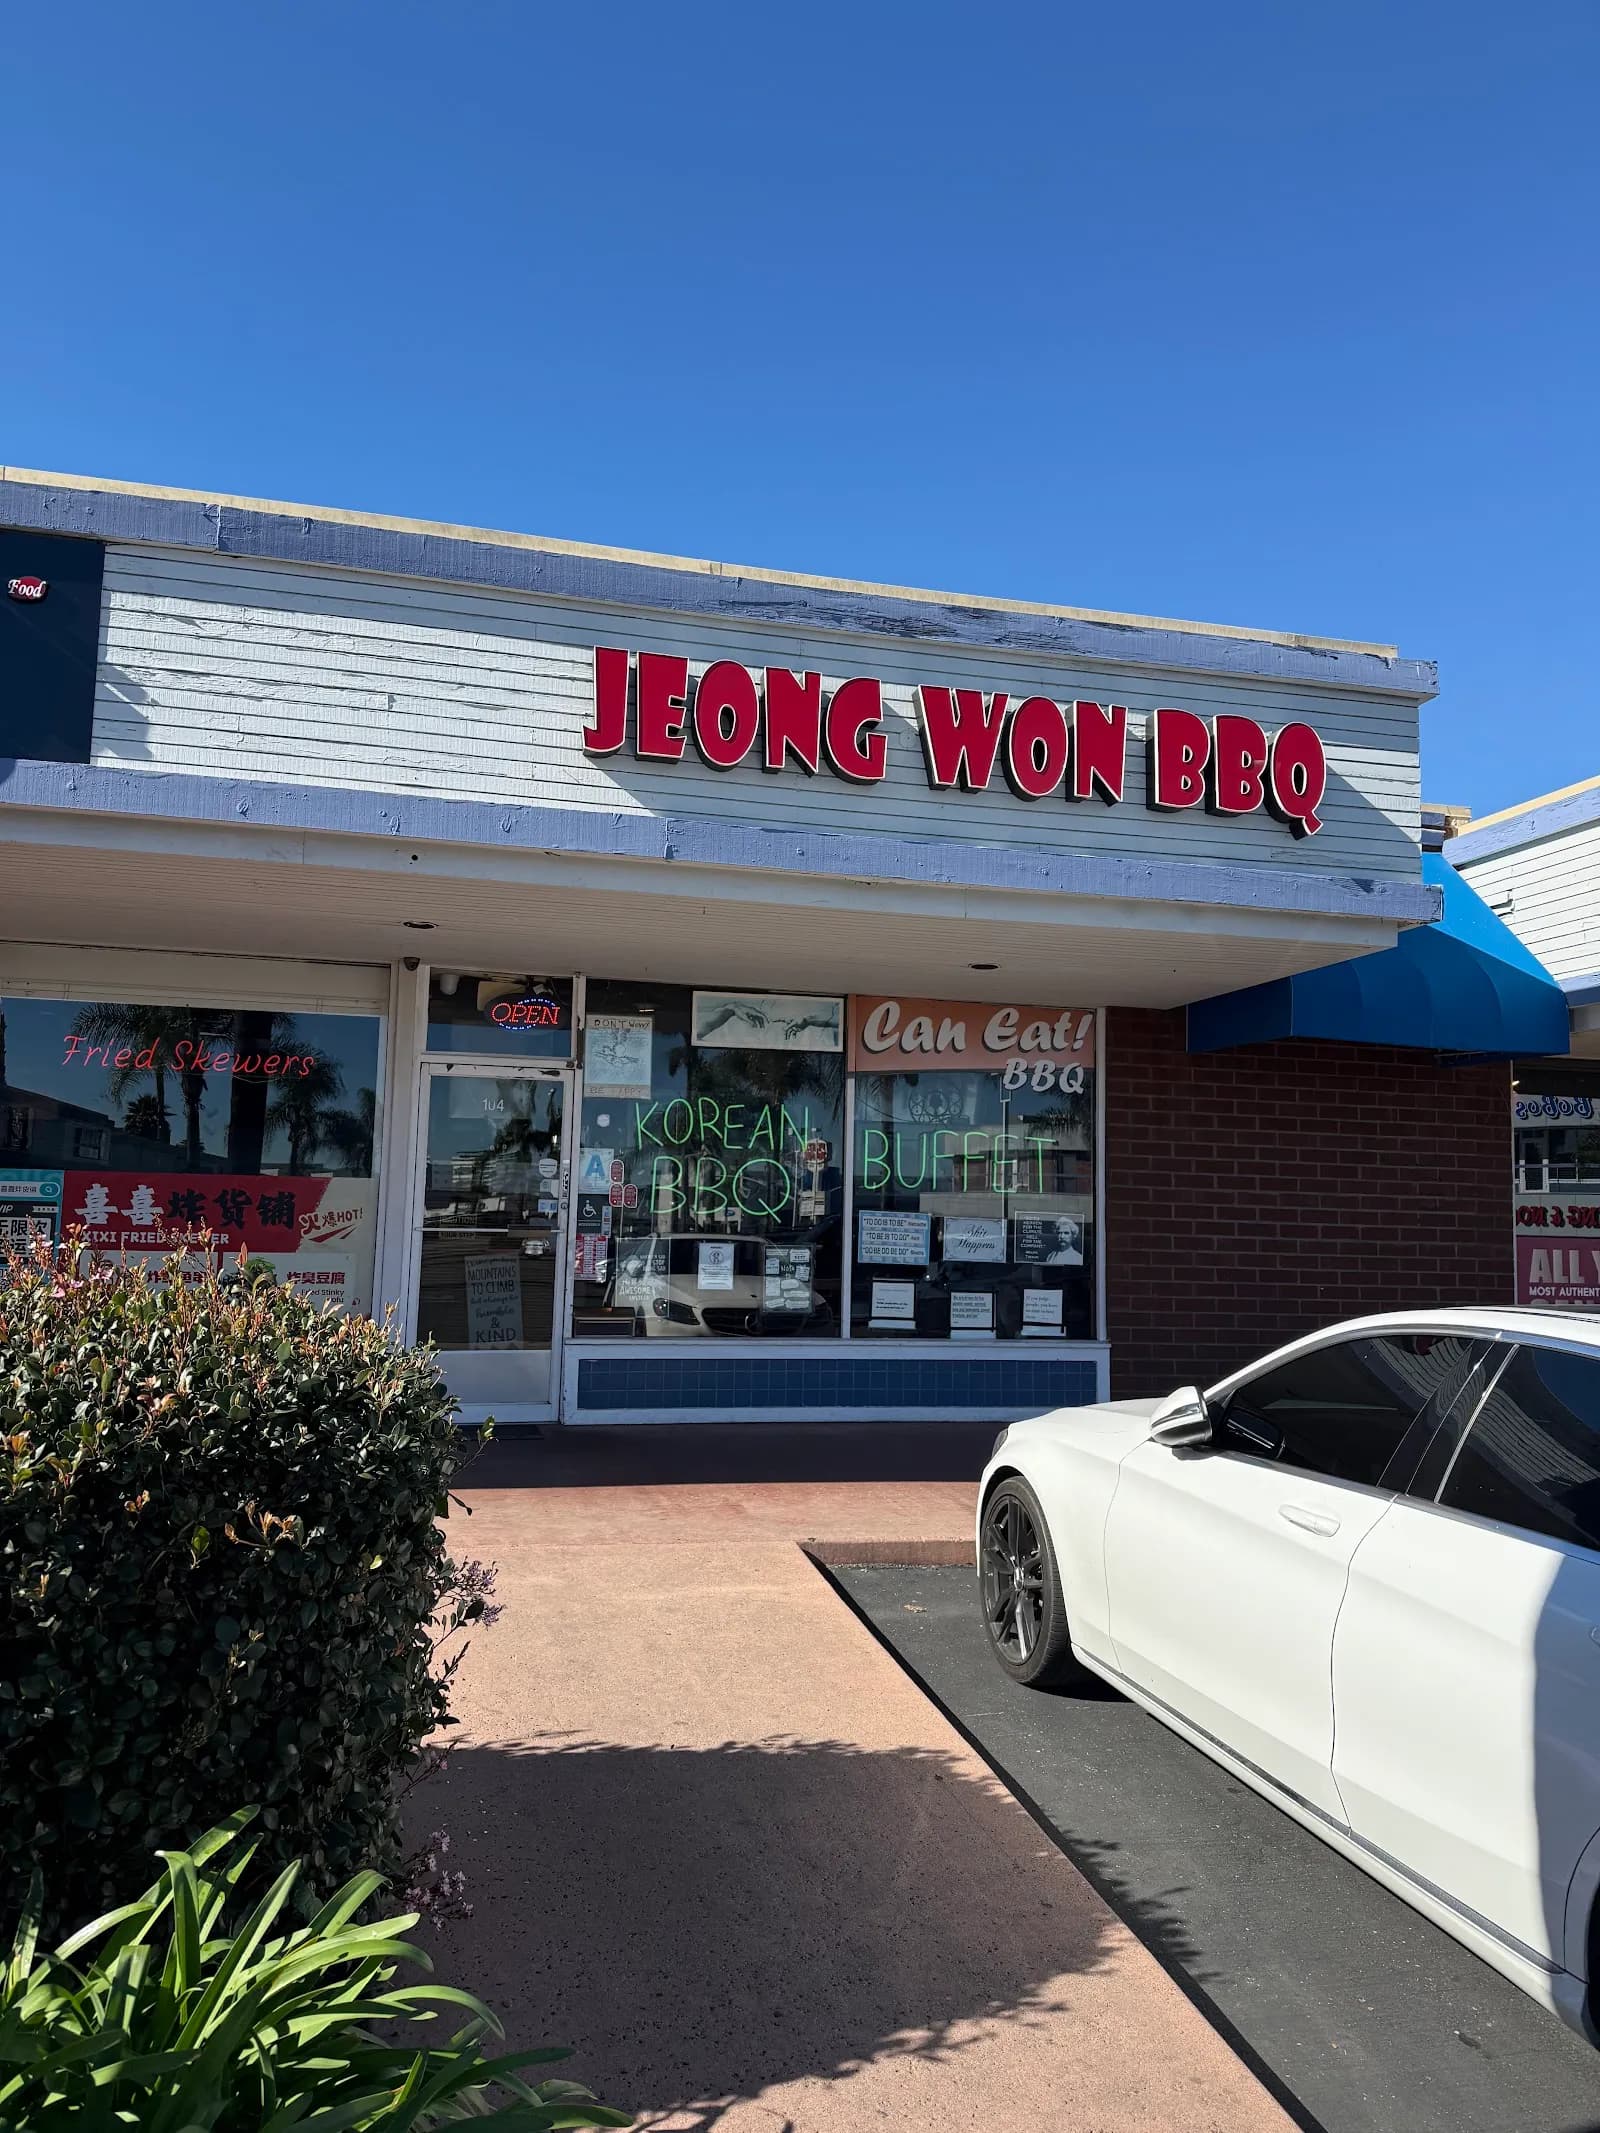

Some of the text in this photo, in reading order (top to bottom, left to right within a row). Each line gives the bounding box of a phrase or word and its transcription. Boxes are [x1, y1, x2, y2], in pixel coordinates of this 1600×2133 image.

[8, 579, 46, 598] Food
[583, 646, 1327, 837] JEONG WON BBQ
[490, 1002, 561, 1024] OPEN
[861, 1000, 1093, 1053] Can Eat!
[62, 1035, 315, 1077] Fried Skewers
[1003, 1057, 1085, 1095] BBQ
[482, 1098, 505, 1112] 104
[635, 1097, 809, 1152] KOREAN
[585, 1152, 606, 1177] A
[863, 1129, 1058, 1194] BUFFET
[650, 1156, 791, 1224] BBQ
[120, 1231, 165, 1244] FRIED
[171, 1231, 230, 1245] KEER
[1529, 1248, 1585, 1284] ALL
[321, 1289, 345, 1297] Stinky
[1529, 1286, 1556, 1297] MOST
[476, 1327, 516, 1343] KIND
